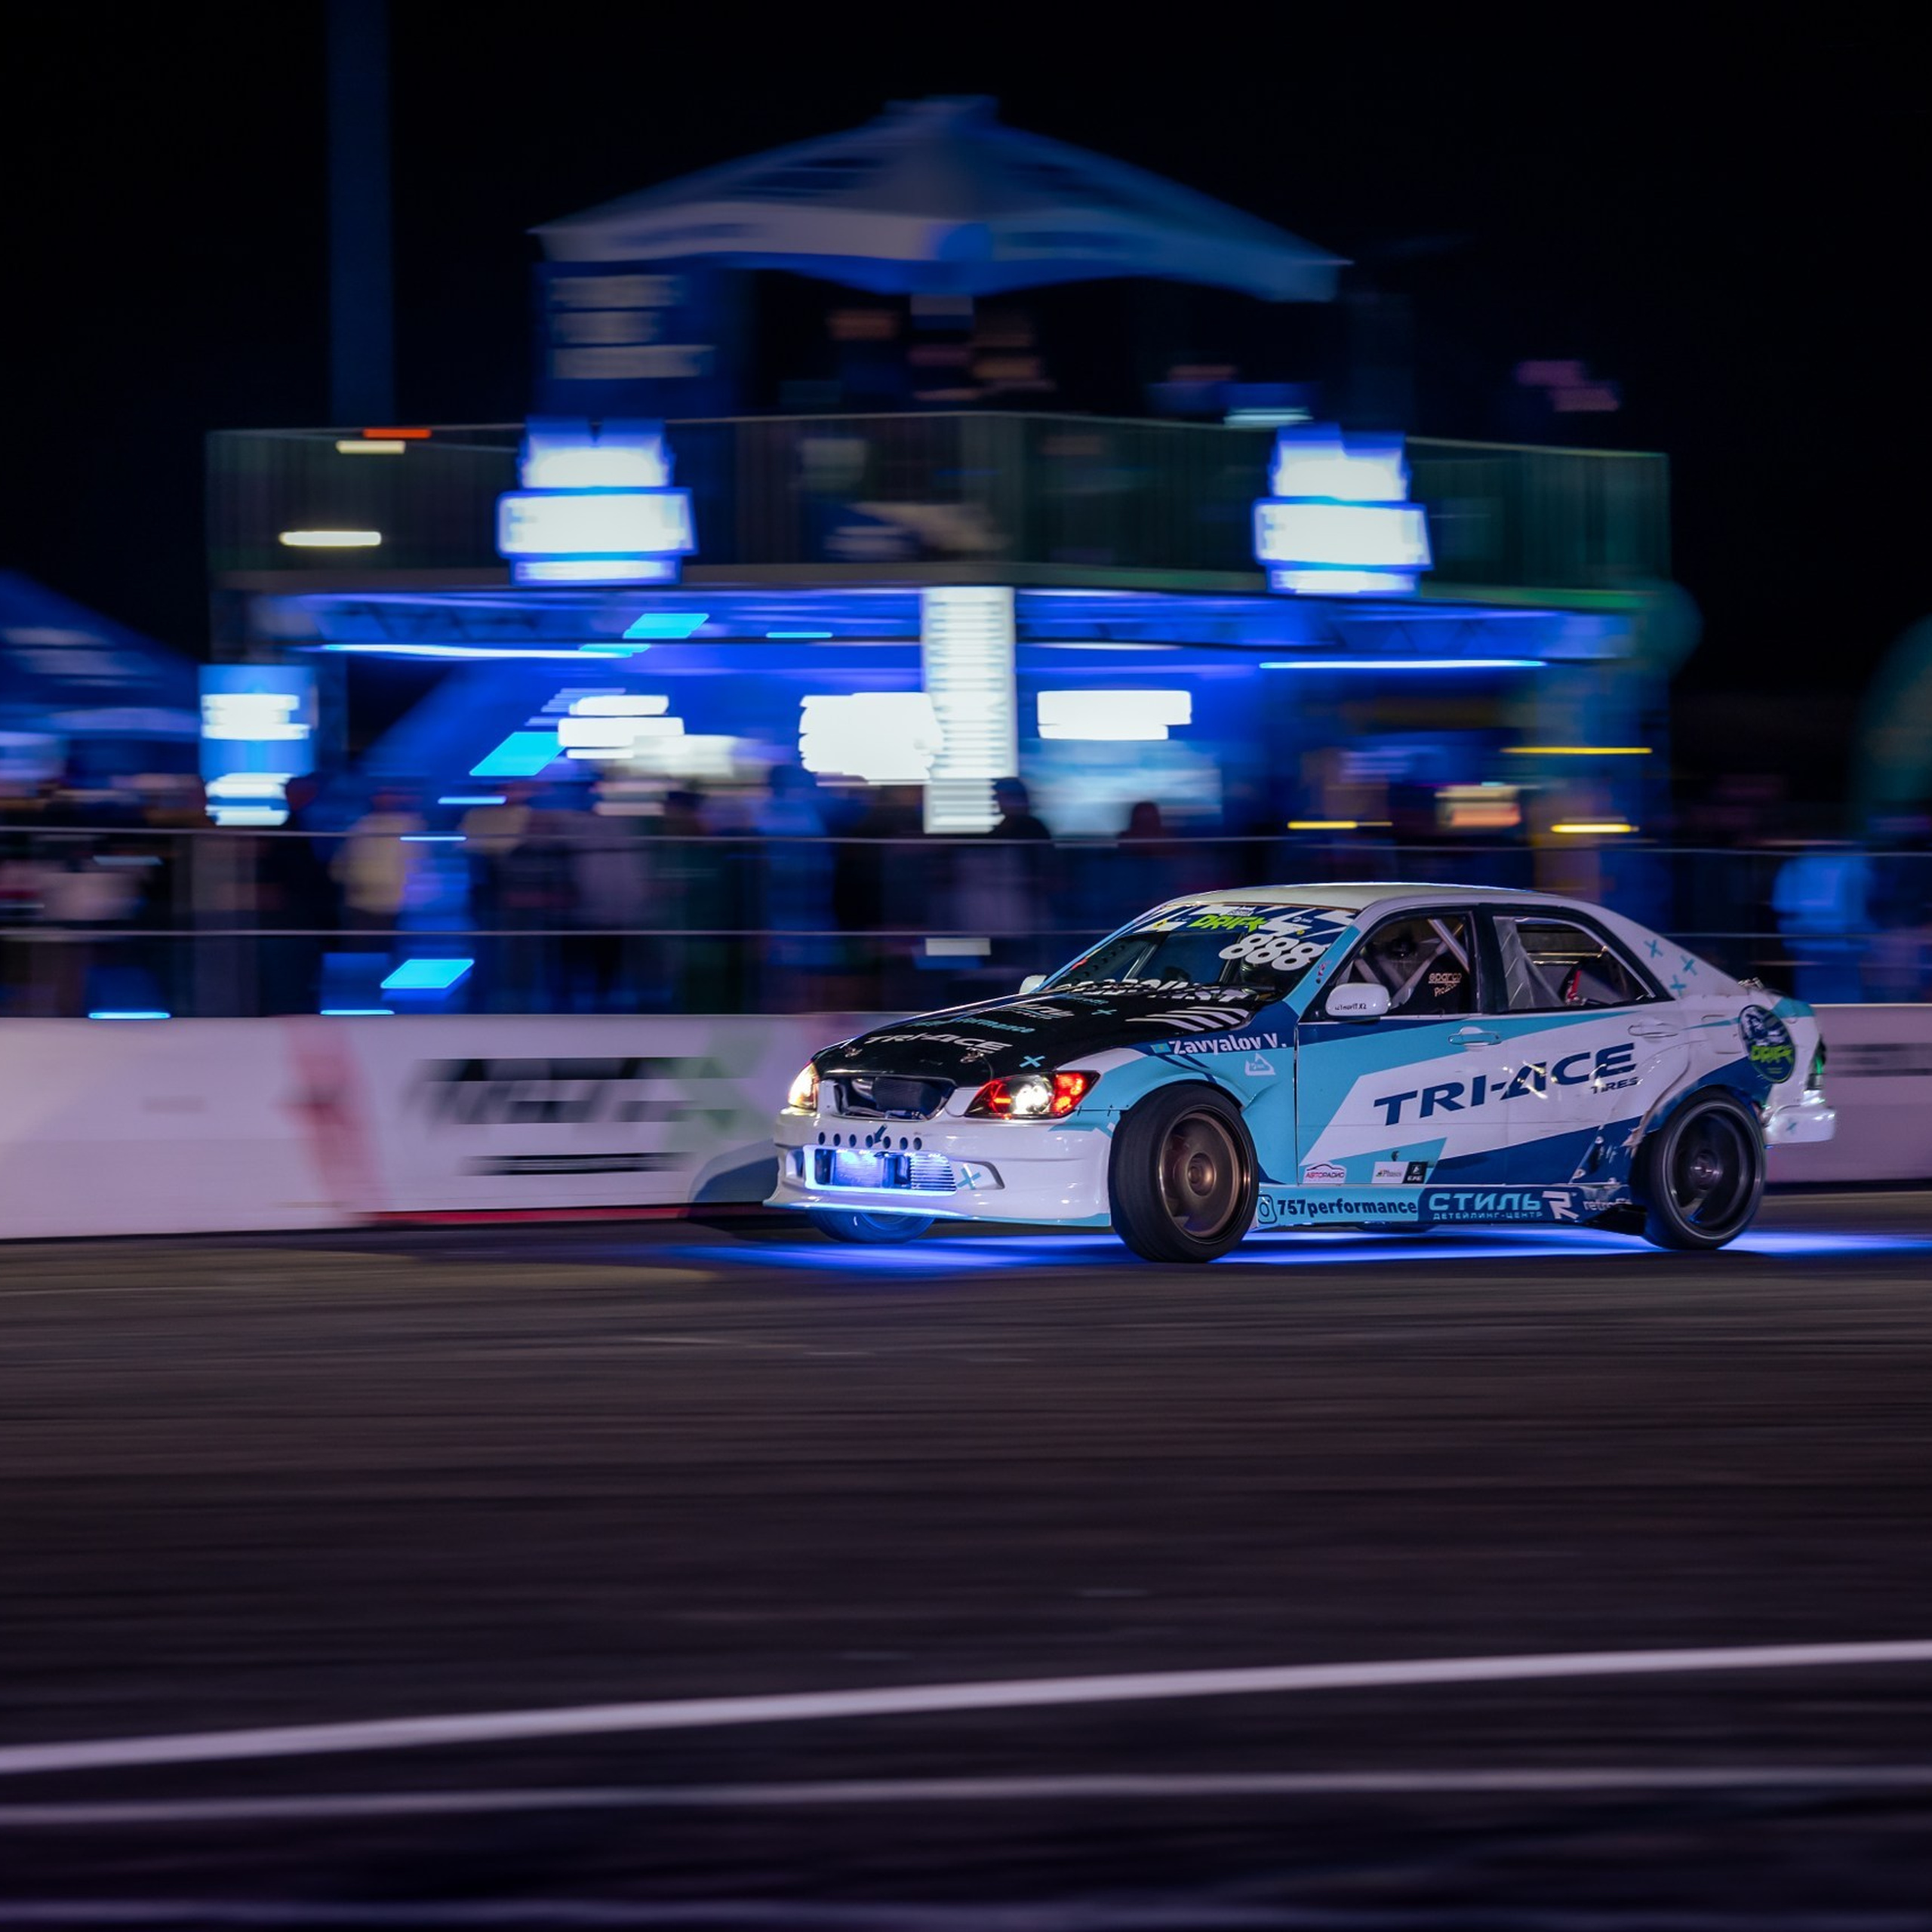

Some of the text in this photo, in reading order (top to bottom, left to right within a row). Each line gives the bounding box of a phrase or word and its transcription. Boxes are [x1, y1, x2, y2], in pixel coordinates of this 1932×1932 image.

[1219, 934, 1333, 971] 888
[1429, 972, 1463, 983] sparco
[864, 1032, 1013, 1052] TRI-ACE
[1168, 1032, 1287, 1055] Zavyalov V.
[1374, 1042, 1638, 1126] TRI-ACE
[1590, 1076, 1638, 1094] TIRES
[1277, 1198, 1417, 1218] 757performance
[1429, 1192, 1541, 1211] СТИЛЬ
[1432, 1211, 1543, 1220] ДЕТЕЙЛИНГ-ЦЕНТР
